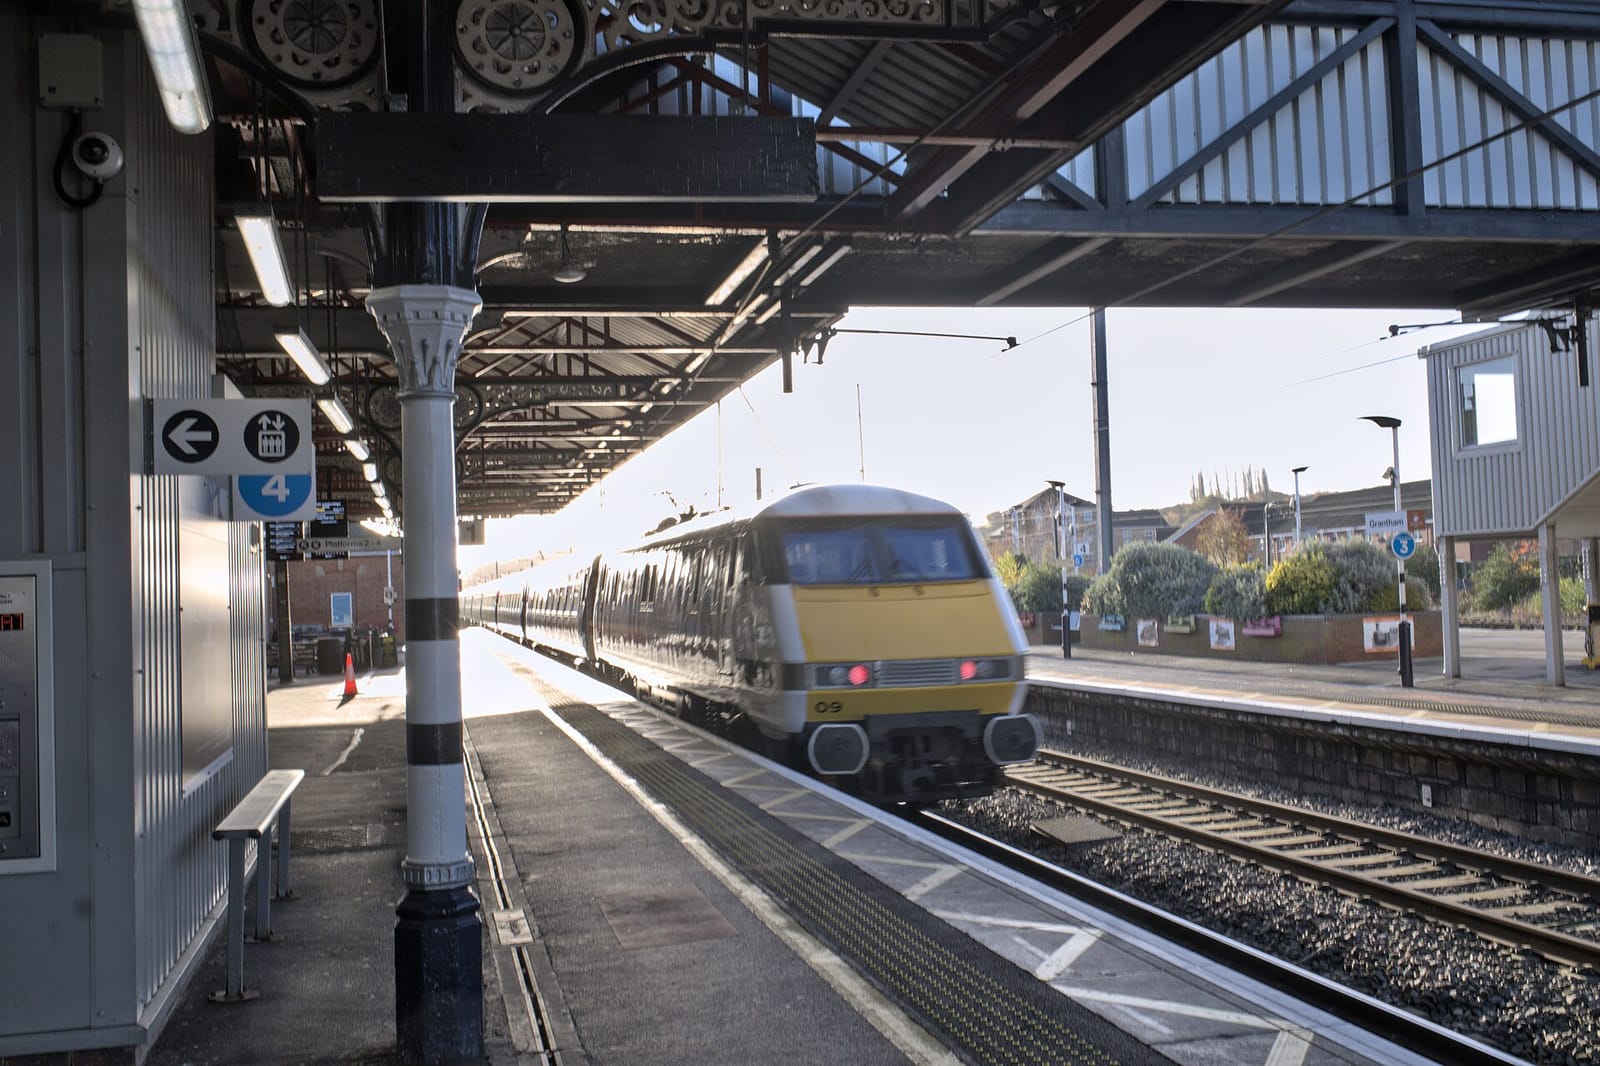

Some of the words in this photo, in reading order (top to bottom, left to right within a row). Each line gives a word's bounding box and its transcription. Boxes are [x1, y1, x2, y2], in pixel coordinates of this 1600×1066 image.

[261, 474, 290, 503] 4
[1369, 518, 1404, 528] Grantham
[1080, 544, 1087, 554] 4
[1400, 539, 1409, 554] 3
[815, 702, 842, 713] 09
